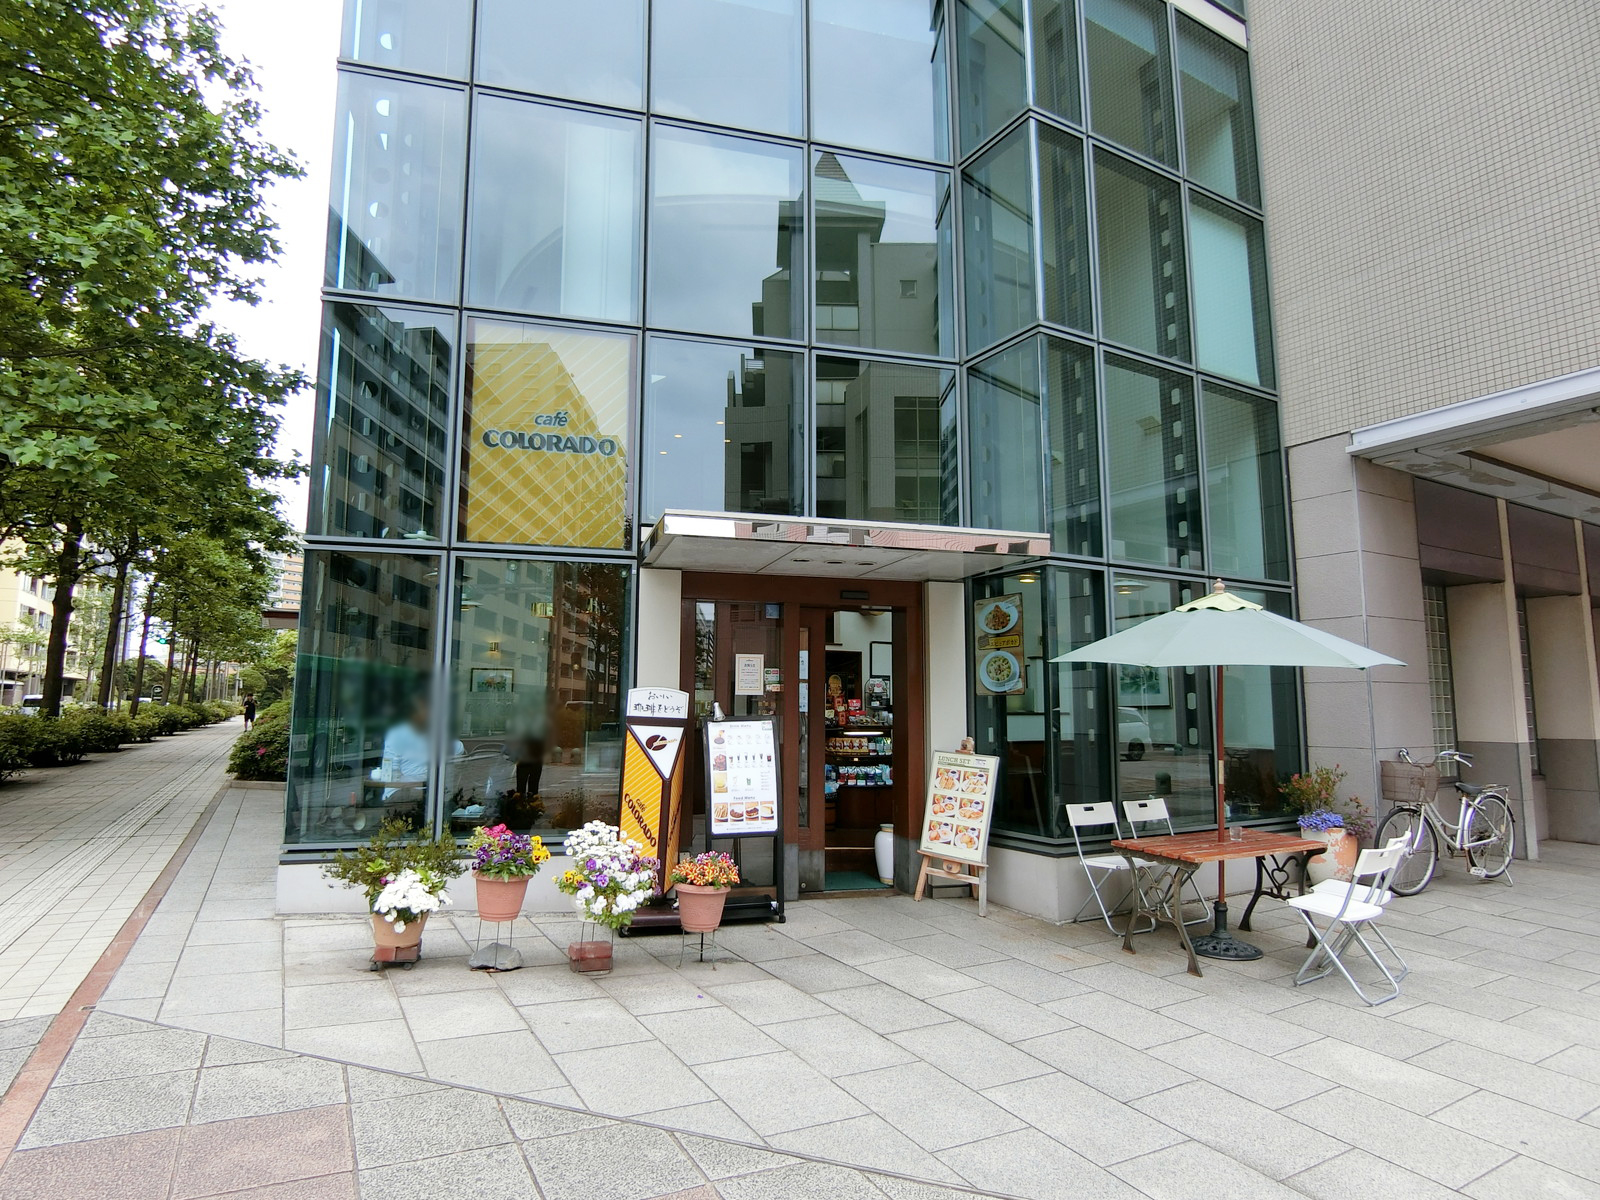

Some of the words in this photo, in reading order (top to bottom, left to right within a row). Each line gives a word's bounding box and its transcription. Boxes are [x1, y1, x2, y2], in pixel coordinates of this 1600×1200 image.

[534, 411, 569, 427] café
[482, 429, 617, 457] COLORADO
[938, 756, 959, 764] LUNCH
[635, 798, 647, 813] café
[624, 793, 657, 848] COLORADO
